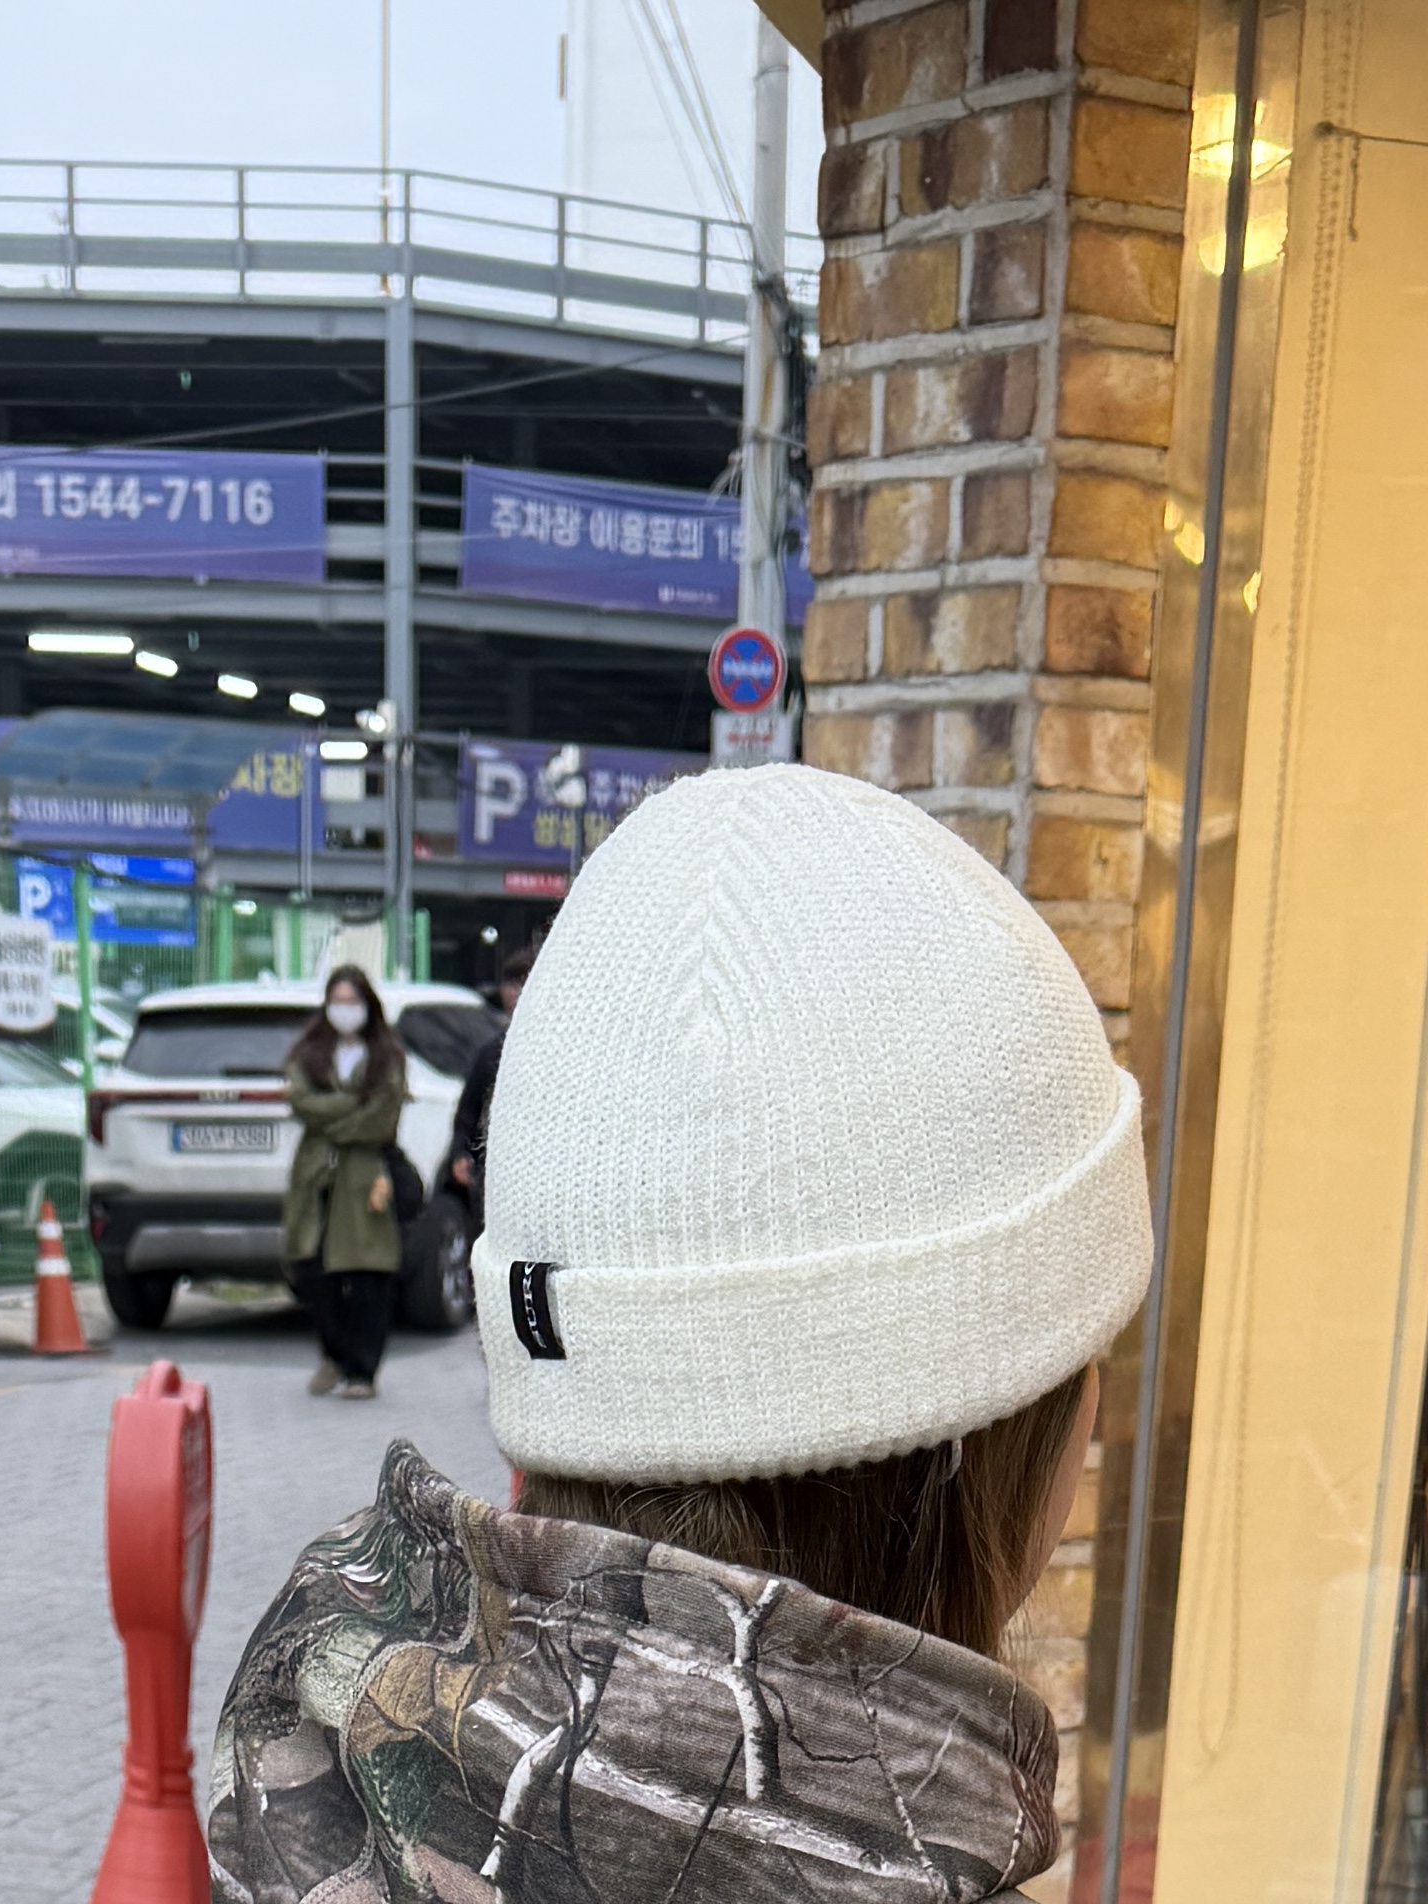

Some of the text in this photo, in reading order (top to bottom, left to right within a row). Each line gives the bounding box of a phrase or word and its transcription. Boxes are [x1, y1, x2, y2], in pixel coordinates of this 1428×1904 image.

[32, 474, 275, 526] 1544-7116
[491, 497, 582, 548] 주차장
[590, 509, 705, 560] 이용문의
[474, 758, 528, 843] P
